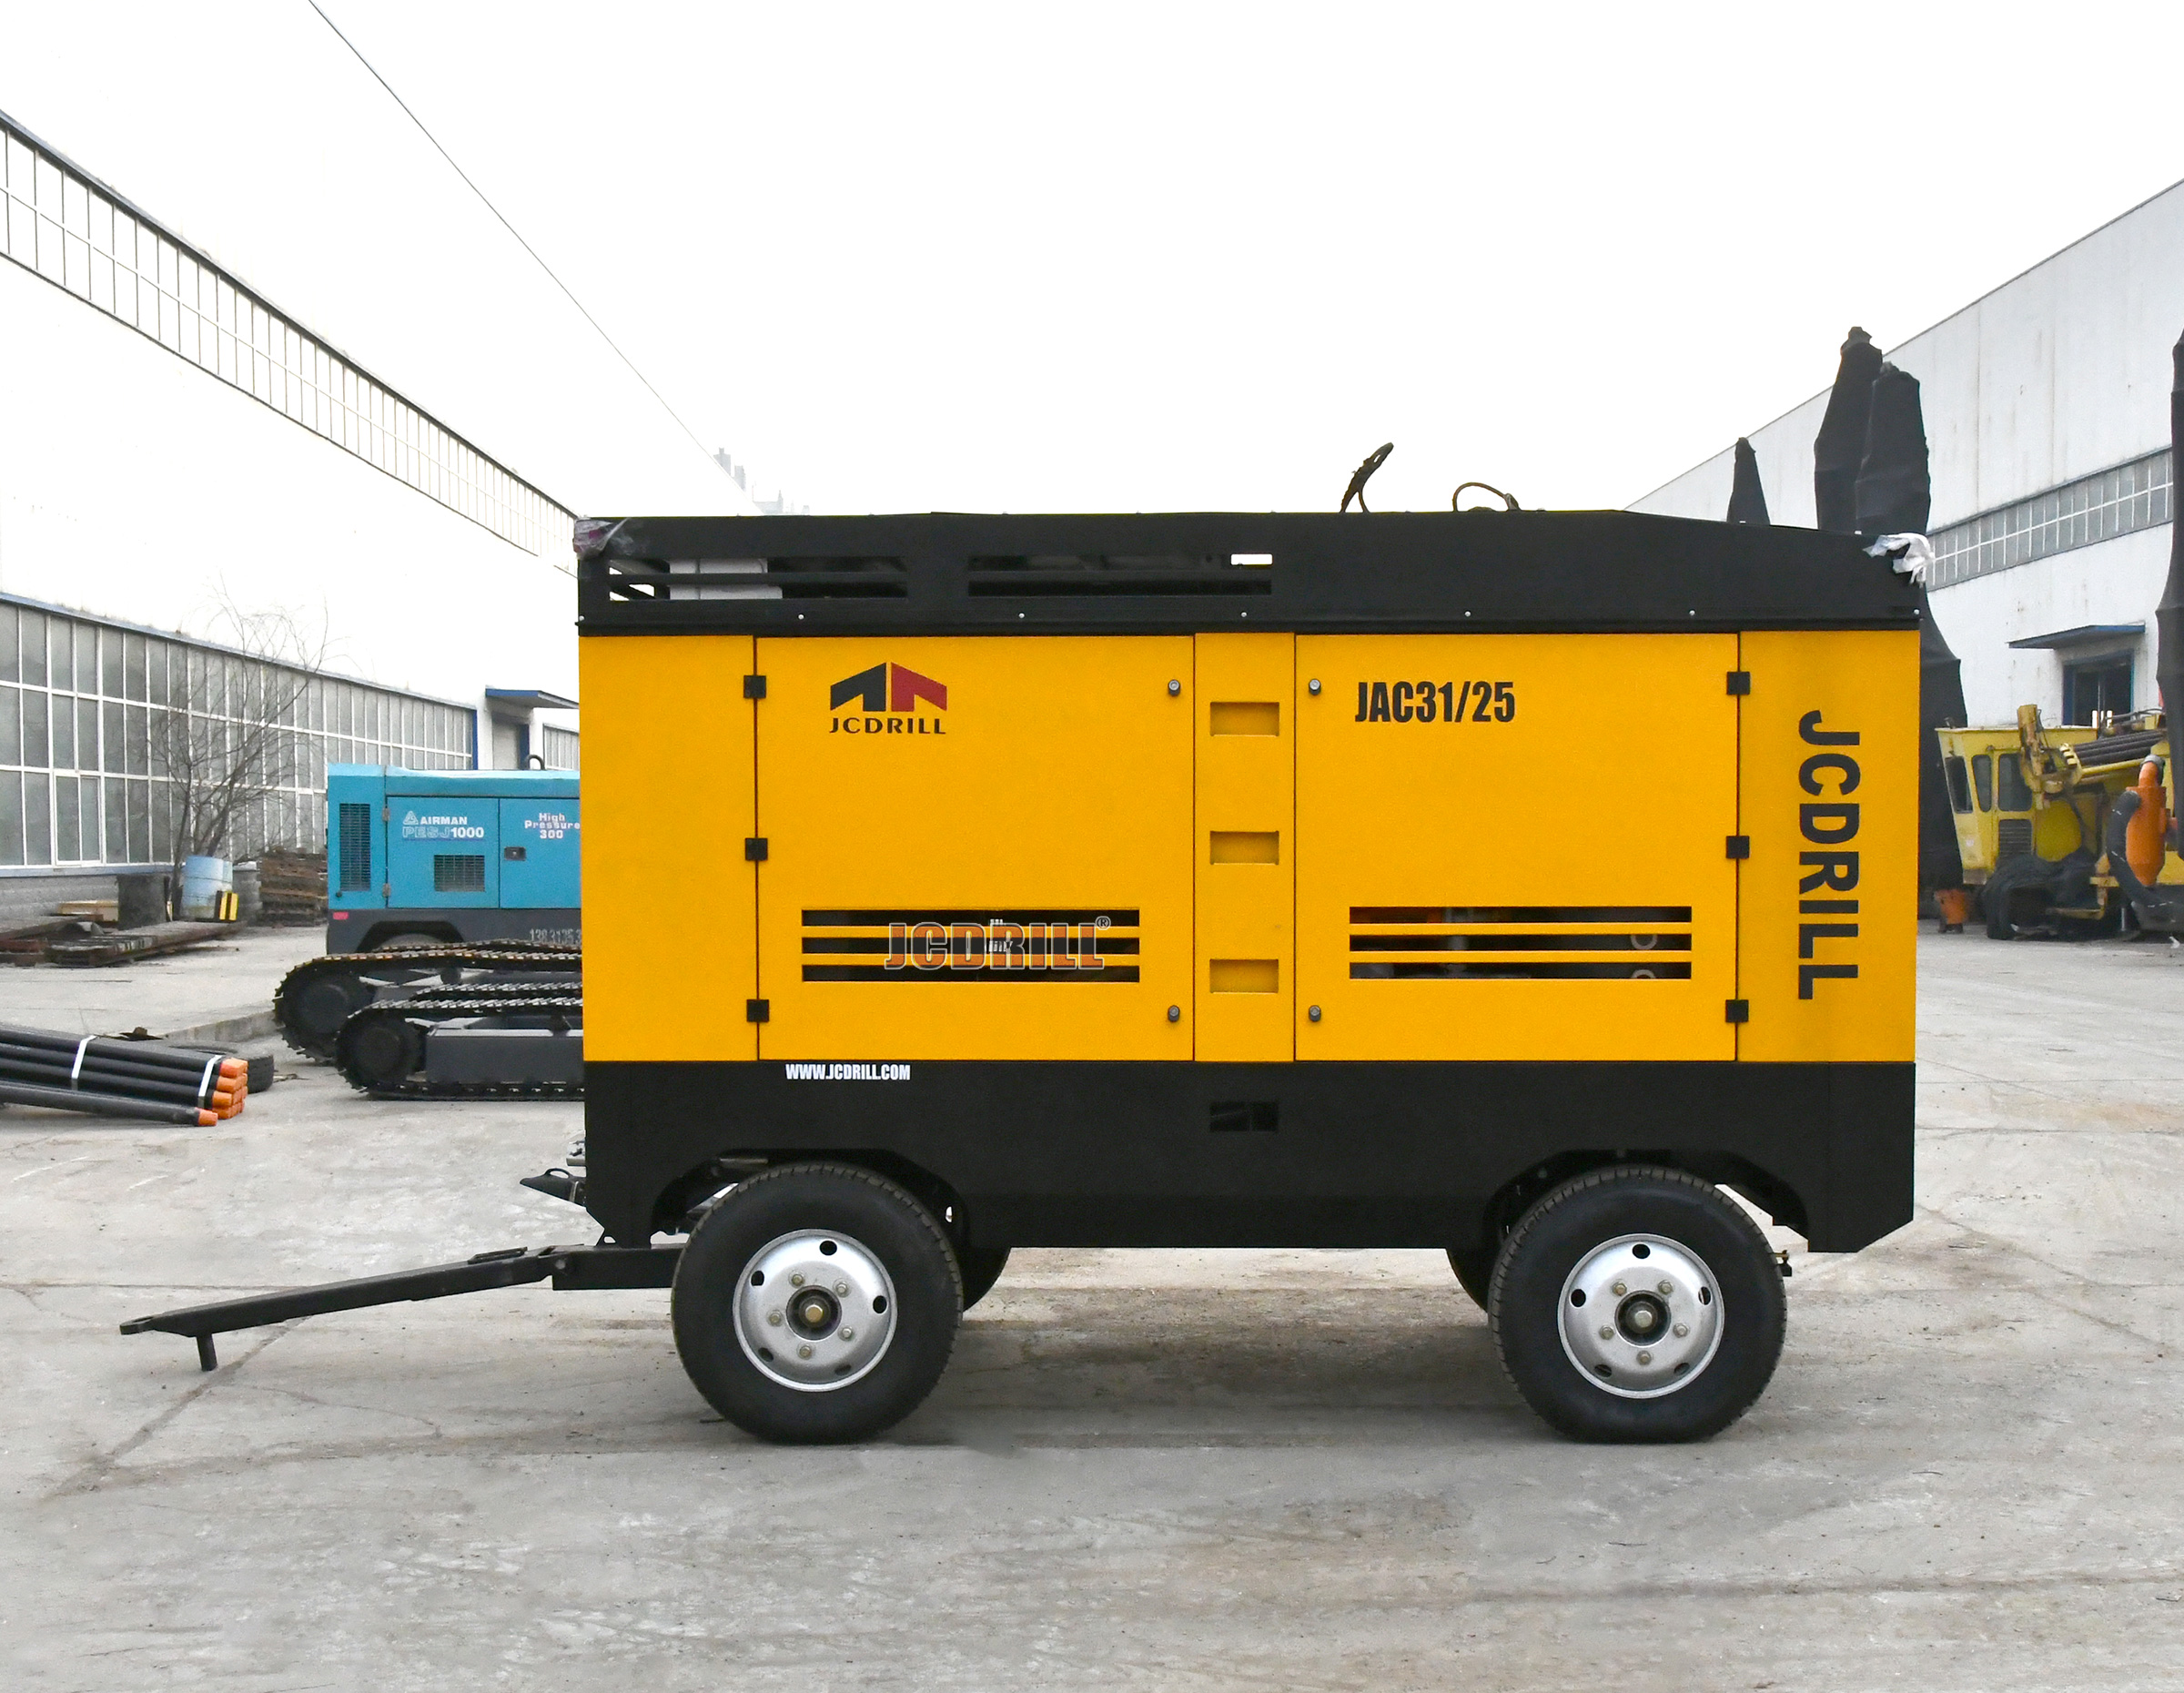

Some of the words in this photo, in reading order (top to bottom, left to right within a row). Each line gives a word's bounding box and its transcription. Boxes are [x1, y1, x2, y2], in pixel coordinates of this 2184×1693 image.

[1355, 681, 1516, 723] JAC31/25
[830, 716, 946, 735] JCDRILL
[420, 816, 468, 826] AIRMAN
[524, 819, 581, 830] Pressure
[538, 812, 566, 823] High
[539, 828, 564, 839] 300
[1798, 709, 1862, 1000] JCDRILL
[784, 1063, 911, 1080] WWW.JCDRILL.COM
